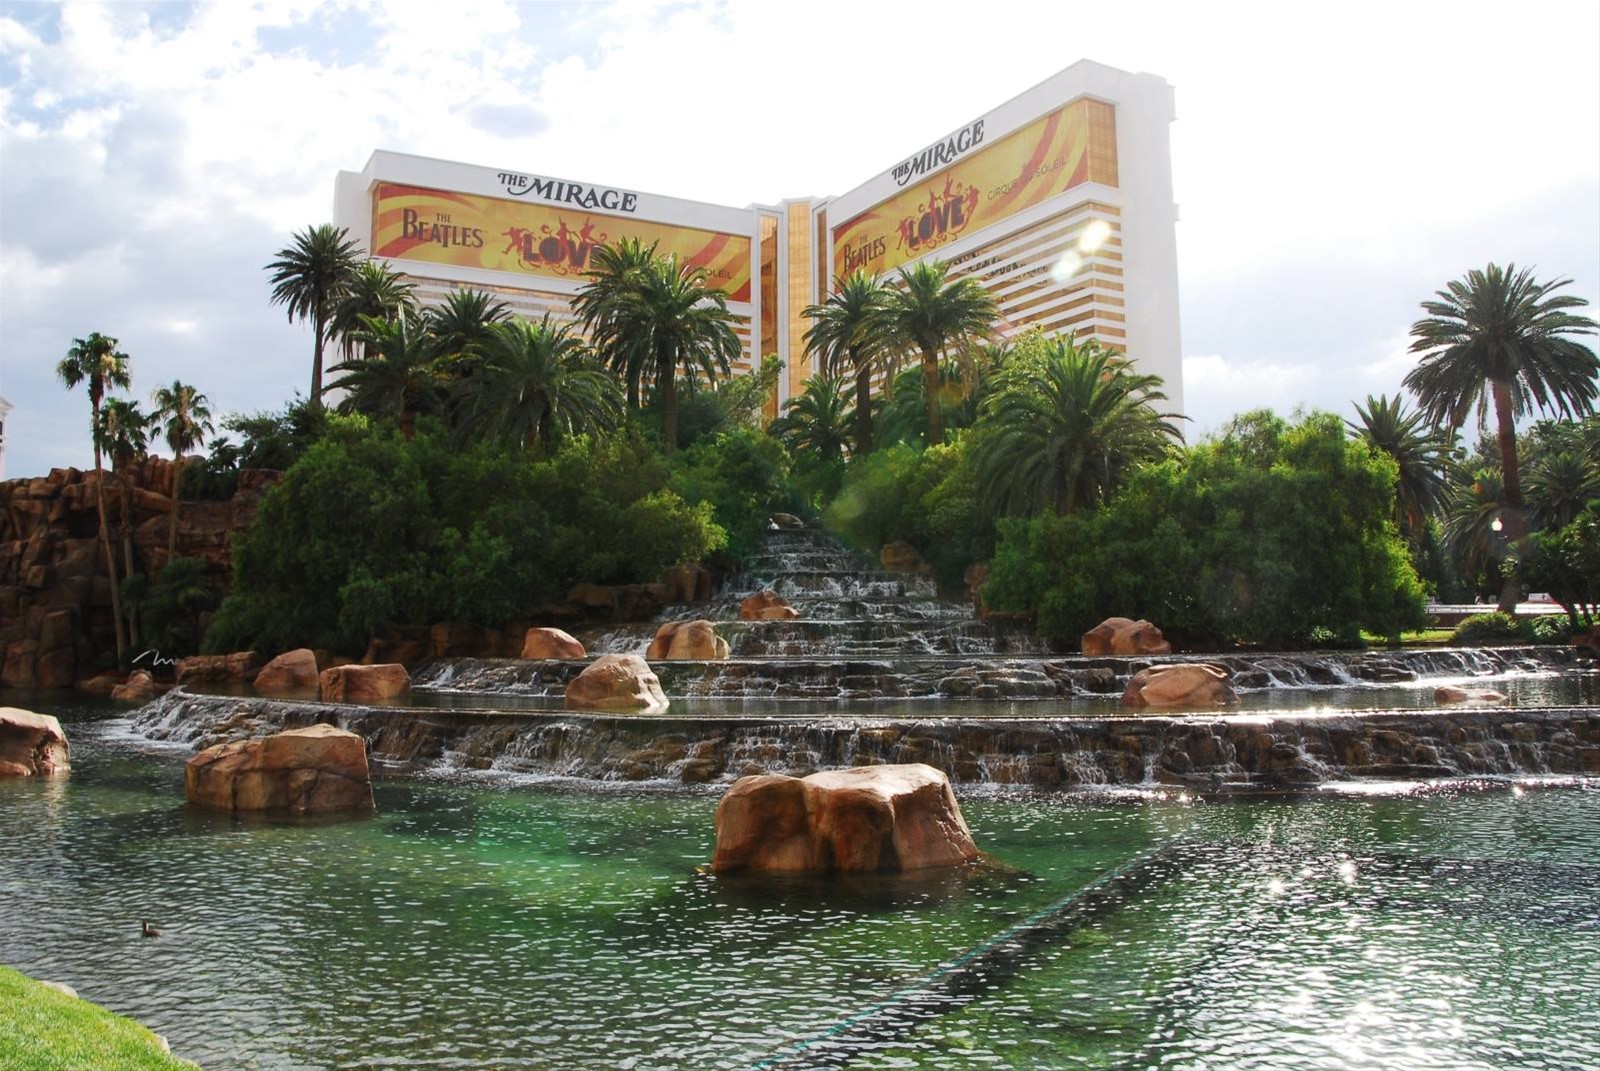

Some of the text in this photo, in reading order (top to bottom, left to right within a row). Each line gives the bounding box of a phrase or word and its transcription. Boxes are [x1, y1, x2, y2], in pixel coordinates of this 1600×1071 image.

[892, 119, 984, 186] THE MIRAGE
[498, 172, 637, 212] THE MIRAGE
[402, 208, 484, 248] BEATLES
[435, 213, 452, 223] THE
[907, 194, 965, 249] LOVE
[700, 268, 732, 279] OLEIL
[843, 236, 886, 273] BEATLES
